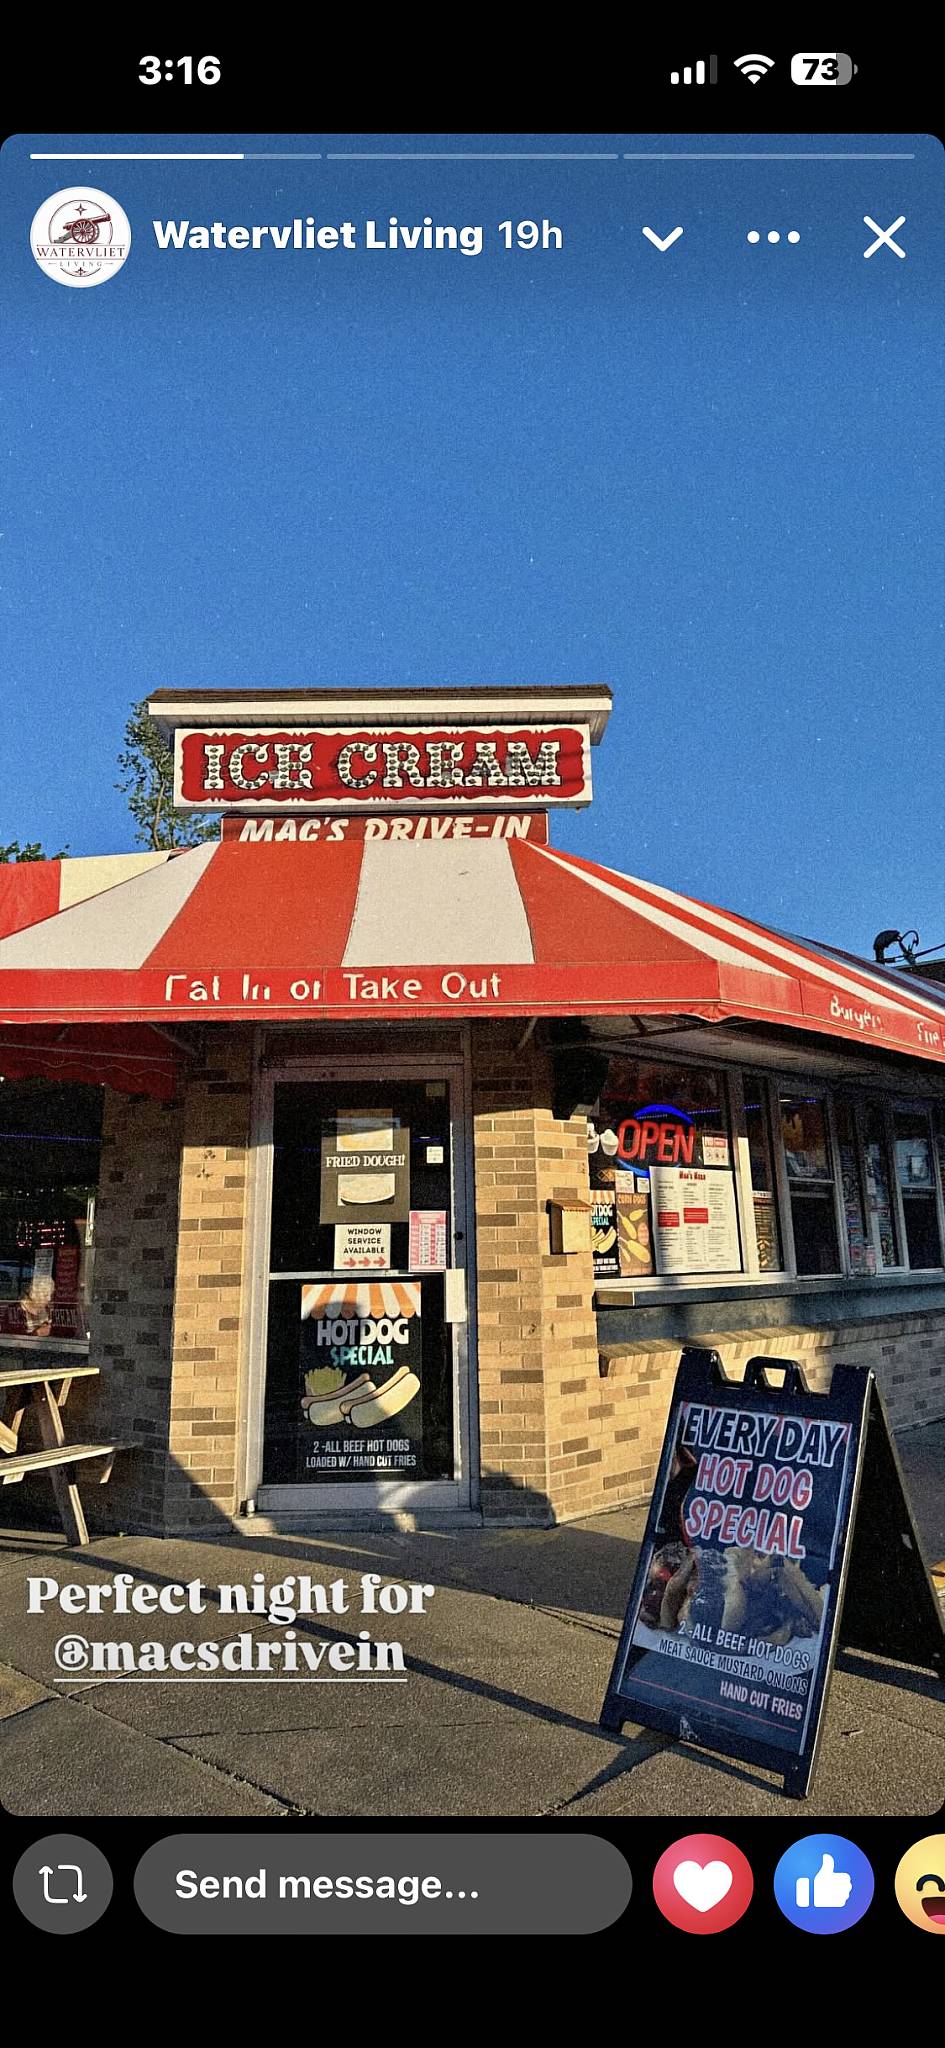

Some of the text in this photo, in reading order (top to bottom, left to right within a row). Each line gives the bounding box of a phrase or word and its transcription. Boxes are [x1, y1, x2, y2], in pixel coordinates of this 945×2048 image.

[203, 741, 562, 791] ICE CREAM
[239, 815, 533, 842] MAC'S DRIVE-IN
[342, 972, 423, 1001] Take
[441, 971, 502, 999] Out
[616, 1118, 696, 1164] OPEN
[325, 1153, 406, 1168] FRIED DOUGH!
[599, 1204, 613, 1217] DOG
[343, 1246, 385, 1254] AVAILABLE
[317, 1318, 409, 1346] HOT DOG
[330, 1345, 394, 1366] SPECIAL
[313, 1440, 320, 1453] 2
[343, 1440, 365, 1453] BEEF
[366, 1439, 385, 1452] HOT
[386, 1438, 410, 1452] DOGS
[681, 1402, 847, 1468] EVERY DAY
[306, 1454, 417, 1468] LOADED W/ HAND CUT FRIES
[695, 1452, 814, 1511] HOT DOG
[685, 1496, 807, 1560] SPECIAL
[678, 1620, 687, 1635] 2
[716, 1628, 747, 1652] BEEF
[748, 1637, 773, 1659] HOT
[775, 1645, 810, 1671] DOGS
[659, 1638, 809, 1696] MEAT SAUCE MUSTARD ONIONS
[720, 1680, 804, 1721] HAND CUT FRIES
